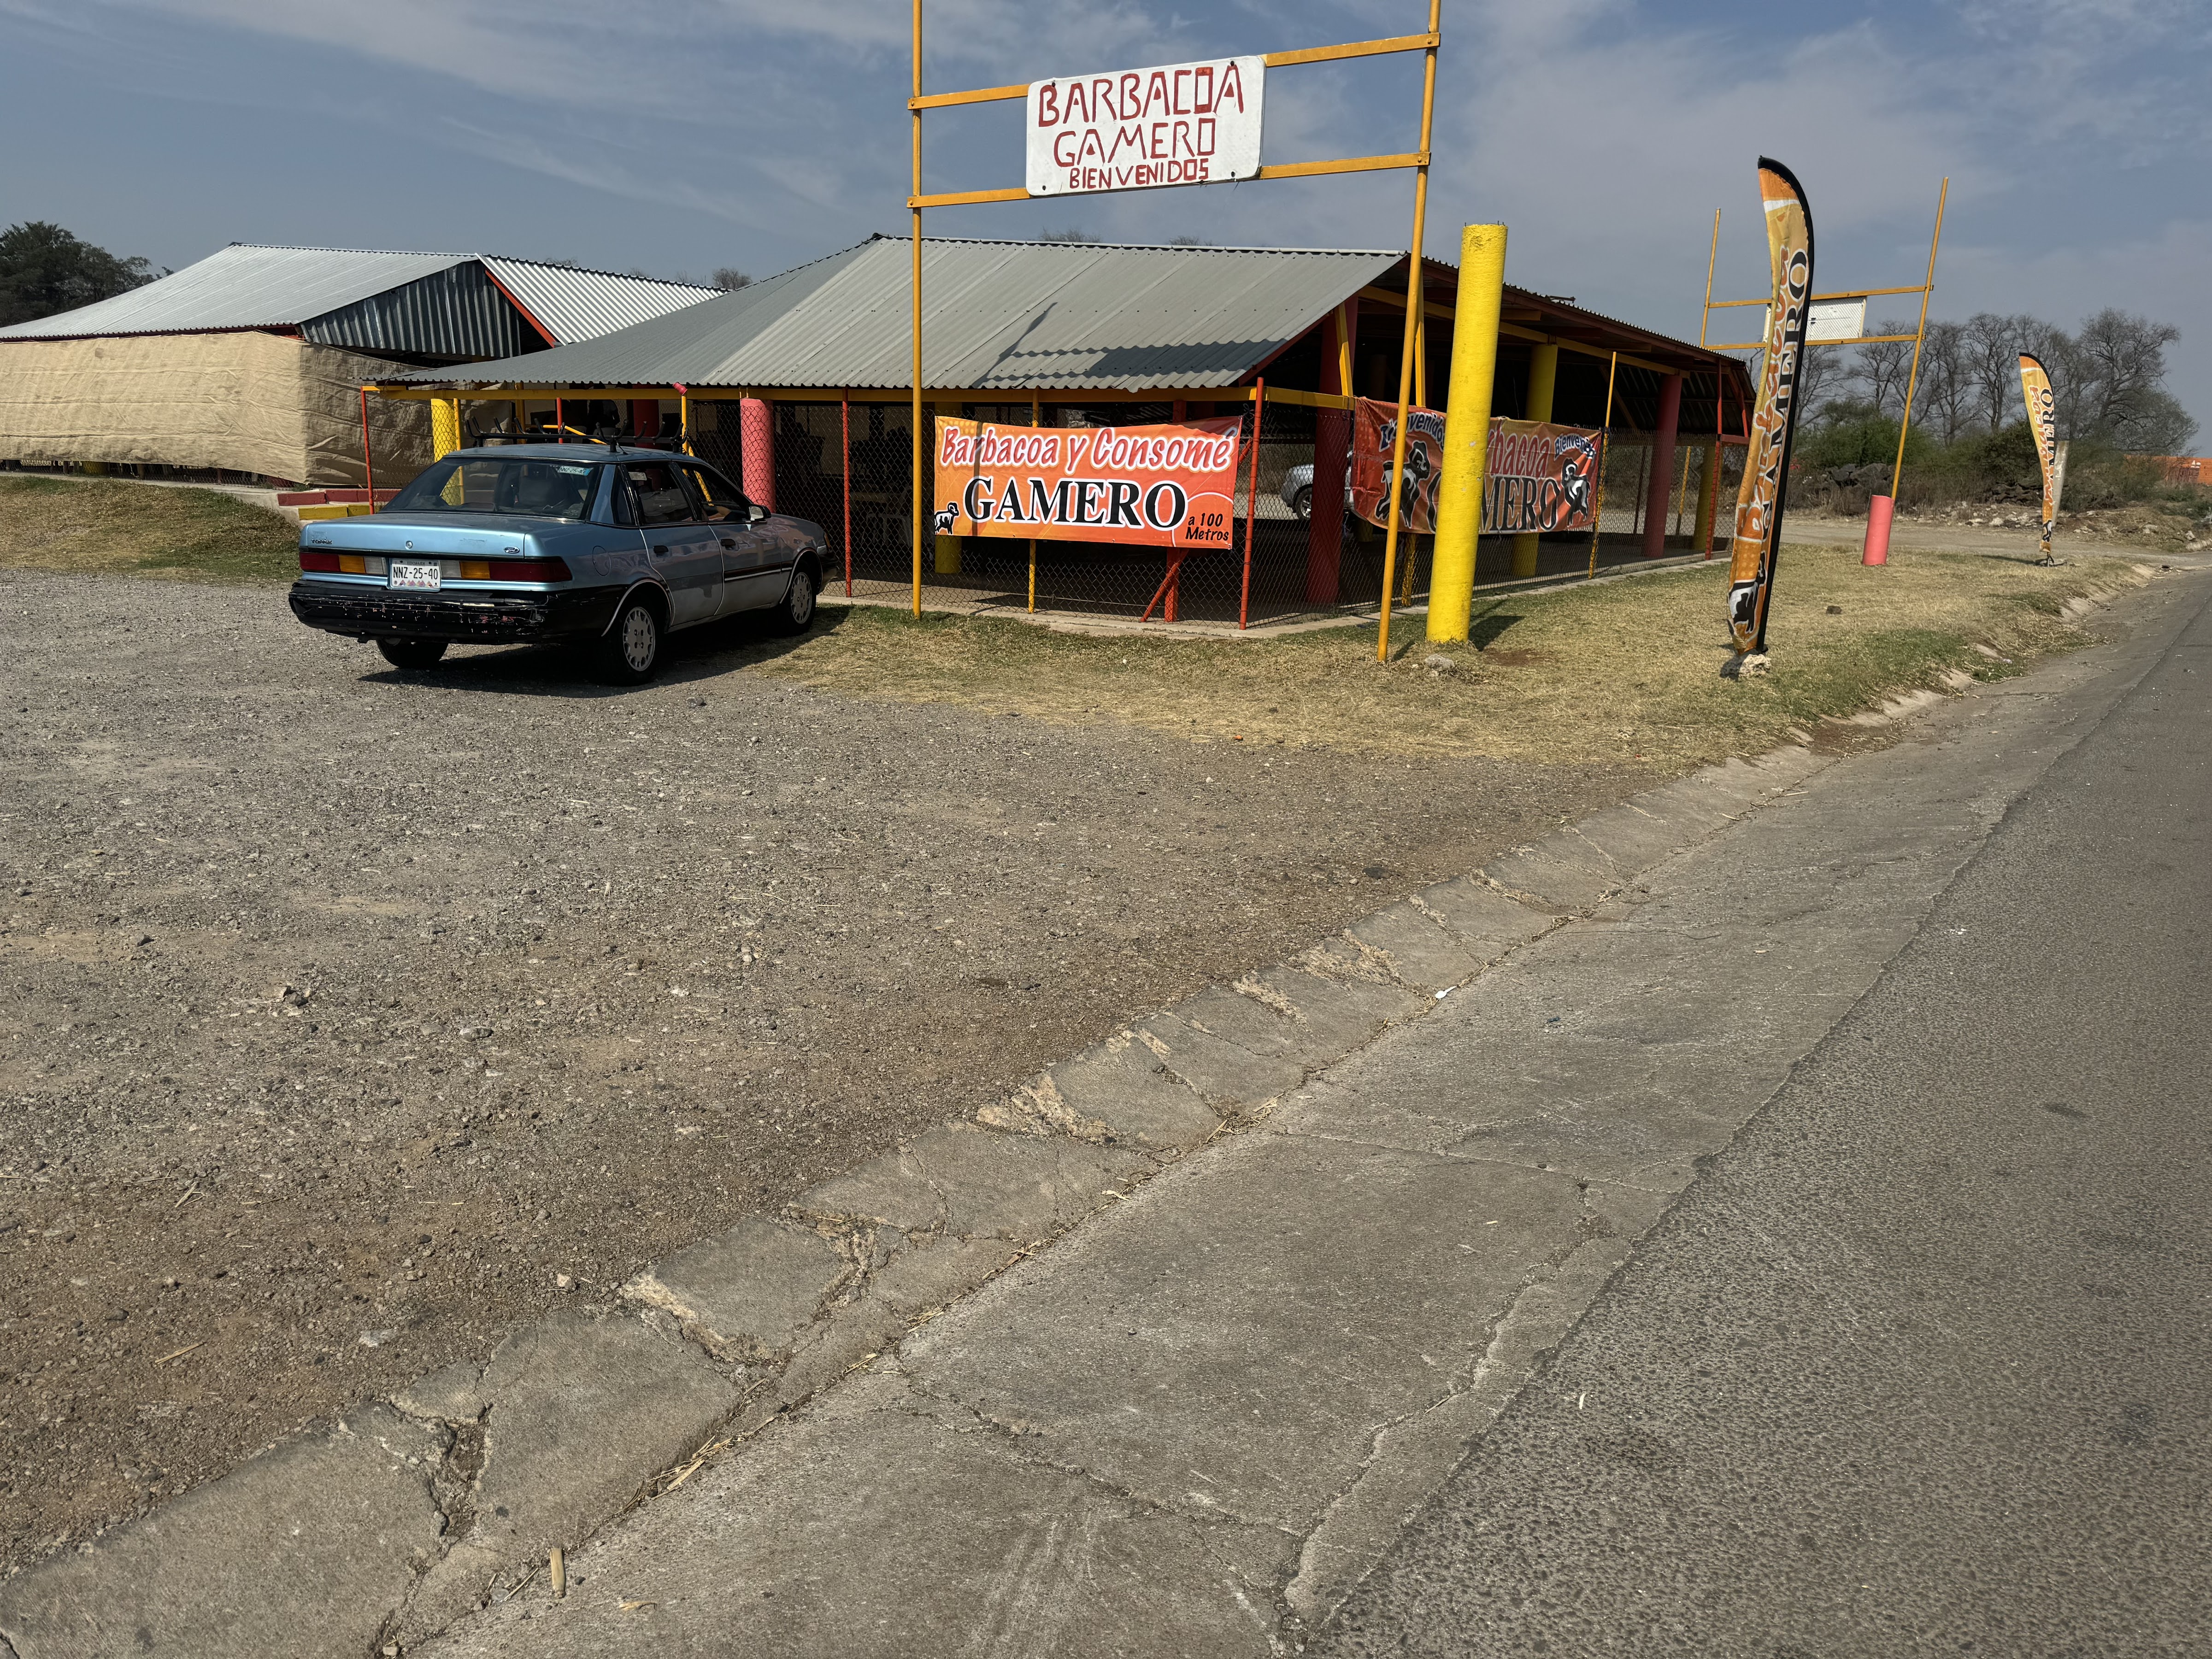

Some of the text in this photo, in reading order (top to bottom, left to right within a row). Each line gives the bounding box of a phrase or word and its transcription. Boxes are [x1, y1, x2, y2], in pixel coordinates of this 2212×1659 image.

[1038, 64, 1244, 127] BARBACOA
[1053, 118, 1216, 168] GAMERO
[1070, 158, 1209, 189] BIENVENIDOS
[941, 428, 1235, 472] Barbacoa y Consomé
[966, 477, 1186, 528] GAMERO
[1188, 512, 1223, 527] a 100
[1185, 526, 1229, 541] Metros
[393, 566, 438, 580] NNZ-25-40
